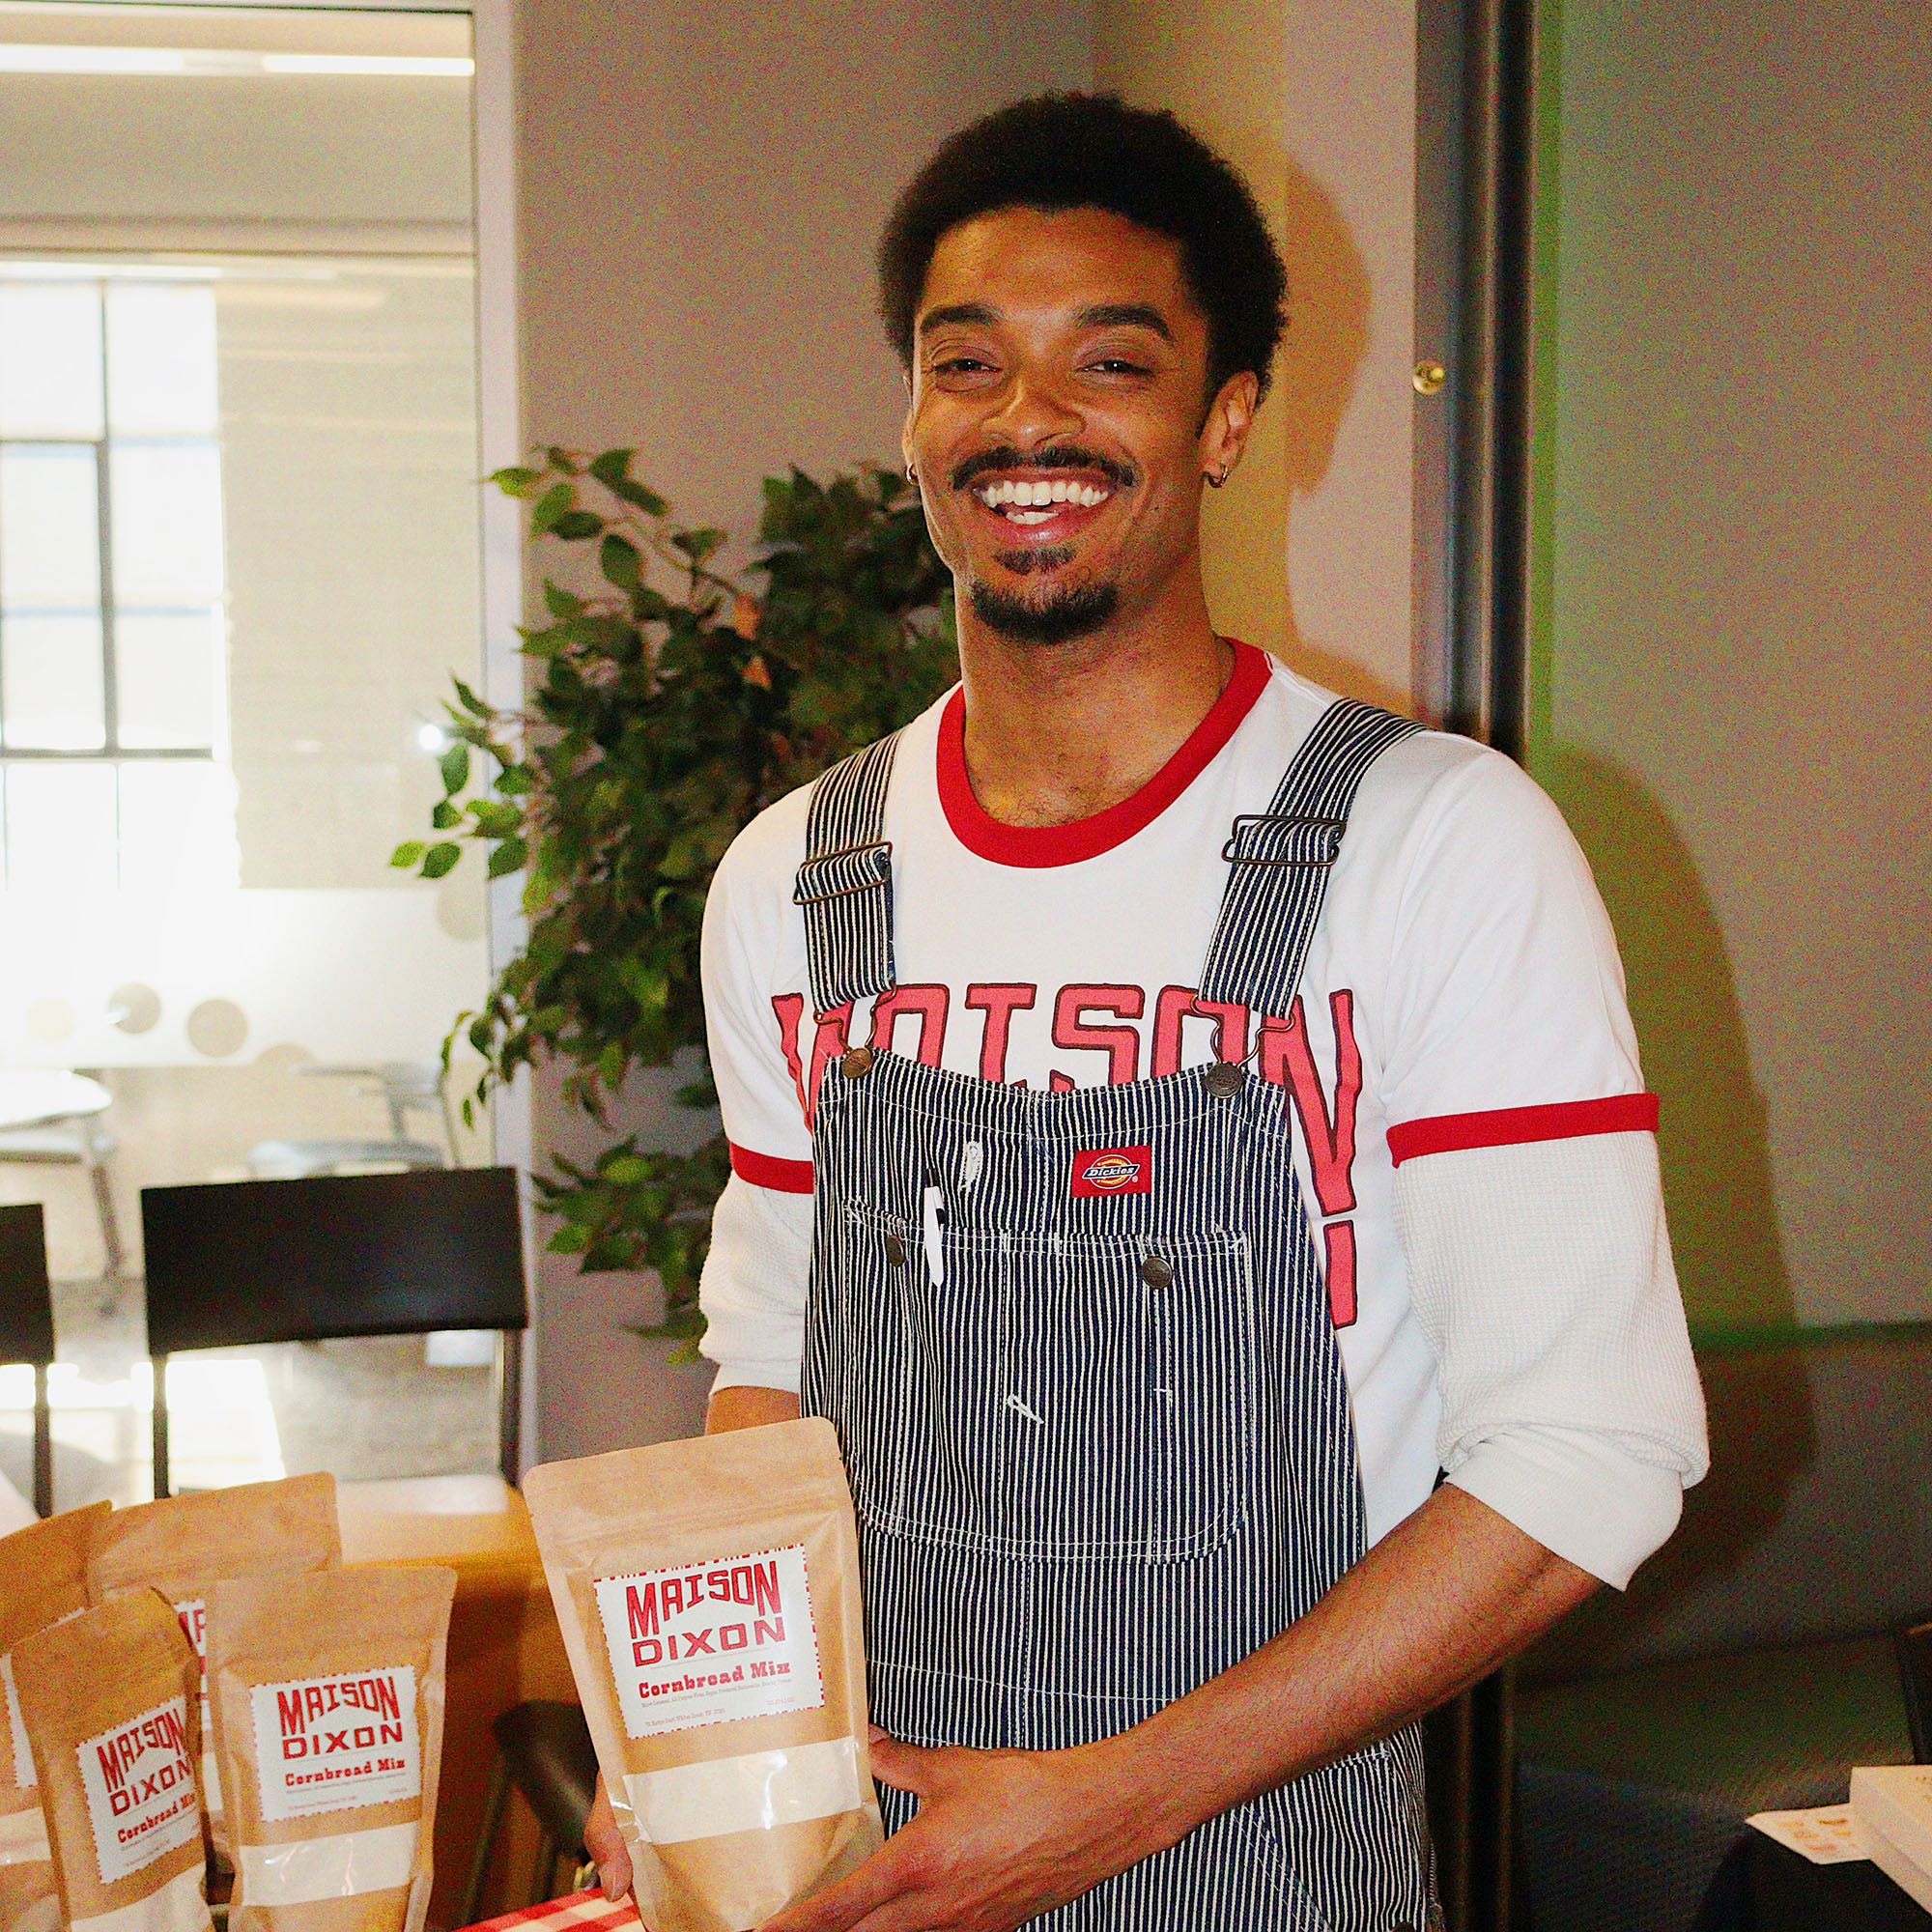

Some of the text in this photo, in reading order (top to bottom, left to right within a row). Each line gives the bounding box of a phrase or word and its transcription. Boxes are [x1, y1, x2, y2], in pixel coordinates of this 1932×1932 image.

[1087, 1166, 1135, 1177] Dickies
[626, 1560, 782, 1639] MAISON
[632, 1616, 786, 1667] DIXON
[639, 1664, 745, 1699] Cornbread
[750, 1660, 791, 1680] Mix
[276, 1676, 401, 1737] MAISON
[97, 1708, 185, 1793] MAISON
[282, 1721, 403, 1760] DIXON
[109, 1758, 191, 1817] DIXON
[285, 1761, 373, 1787] Cornbread
[378, 1757, 406, 1772] Mix
[117, 1801, 179, 1843] Cornbread
